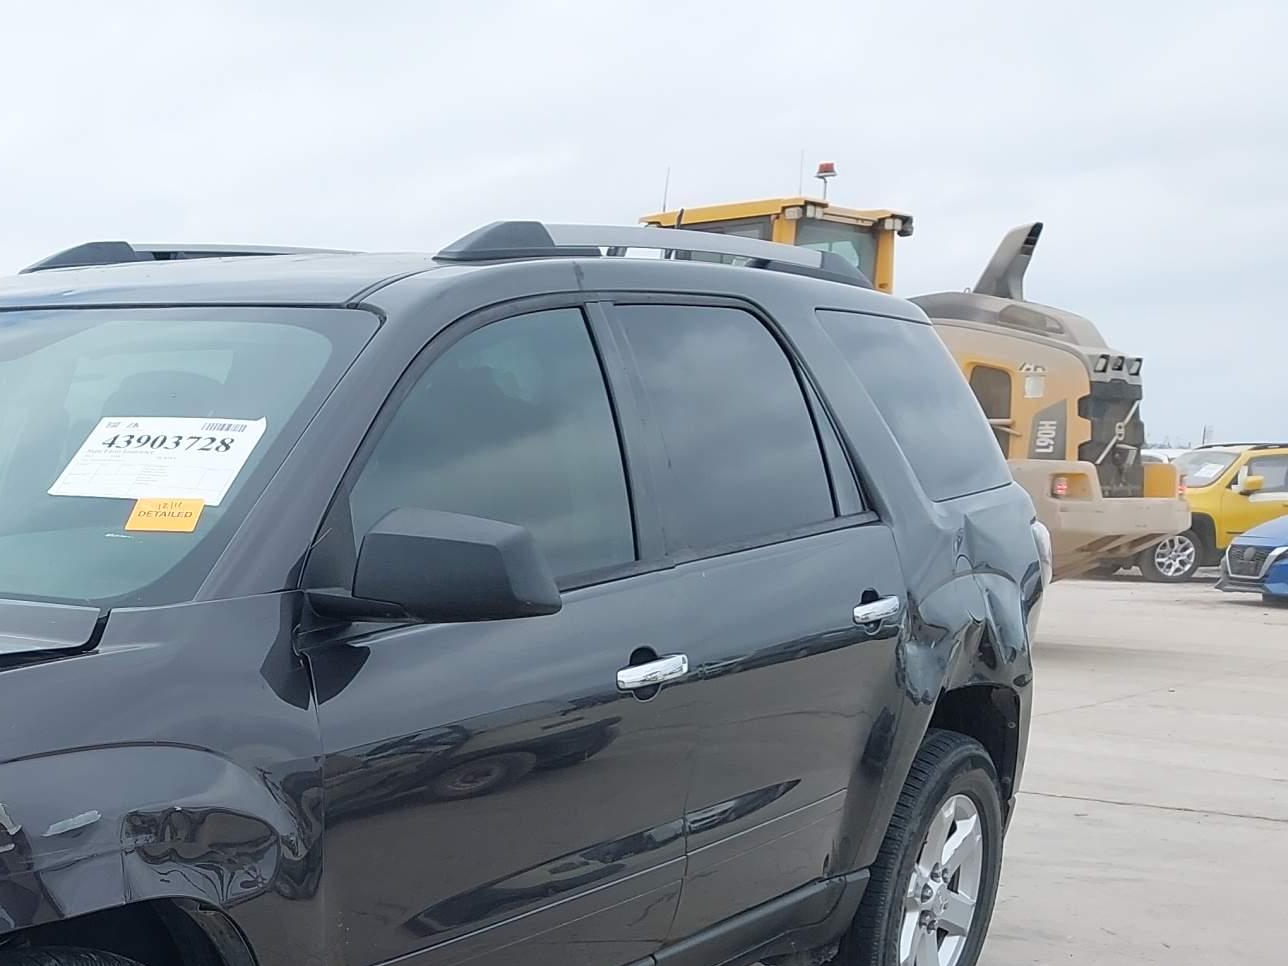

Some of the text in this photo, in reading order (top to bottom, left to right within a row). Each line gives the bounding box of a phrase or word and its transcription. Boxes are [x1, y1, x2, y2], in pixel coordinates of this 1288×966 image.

[102, 434, 235, 453] 43903728
[1035, 420, 1057, 453] L90H
[137, 510, 193, 518] DETAILED
